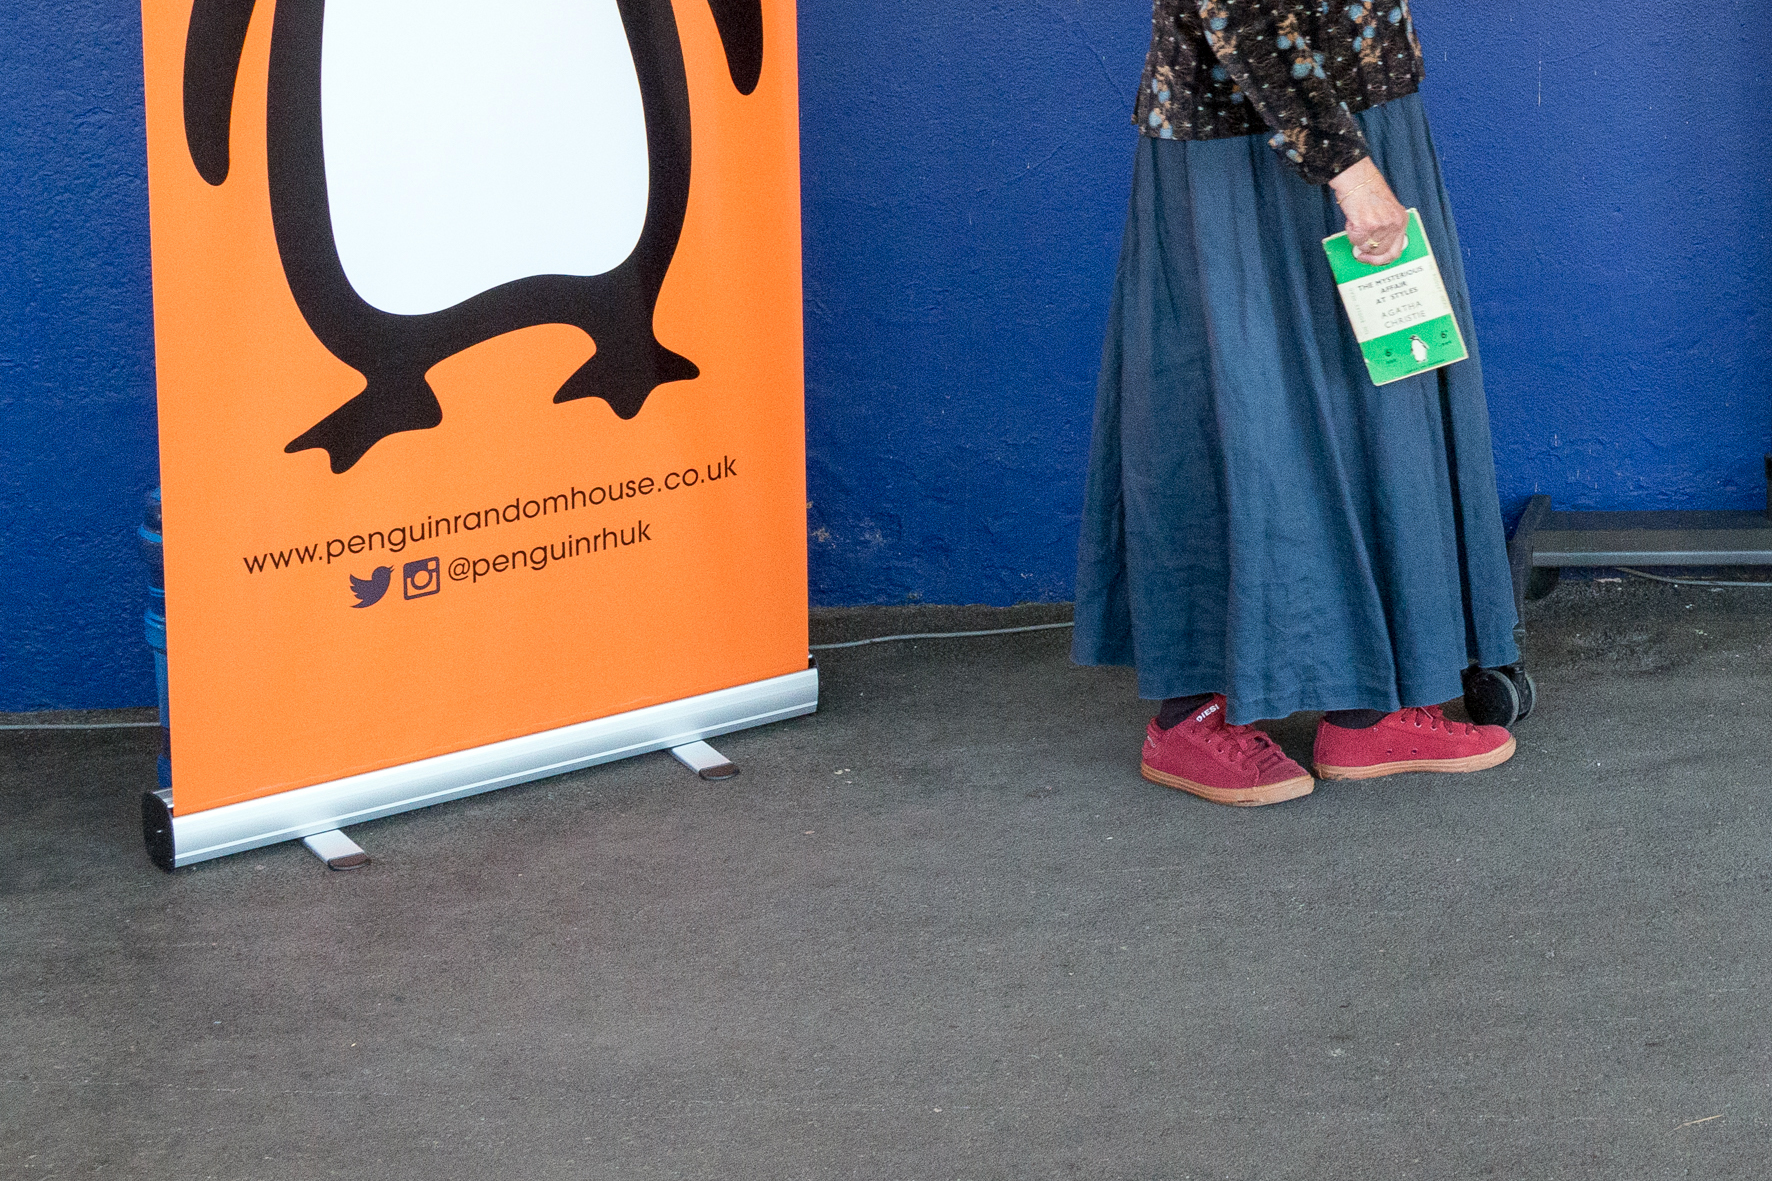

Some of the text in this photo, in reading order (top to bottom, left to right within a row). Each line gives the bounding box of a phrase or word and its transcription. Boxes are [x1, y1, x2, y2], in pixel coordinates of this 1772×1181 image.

[1357, 266, 1424, 291] THE MYSTERIOUS
[1381, 280, 1408, 294] AFFAIR
[1376, 287, 1419, 305] AT STYLES
[1381, 301, 1423, 319] AGATHA
[1383, 310, 1427, 329] CHRISTIE
[242, 454, 739, 576] www.penguinrandomhouse.co.uk
[447, 519, 653, 583] @penguinrhuk
